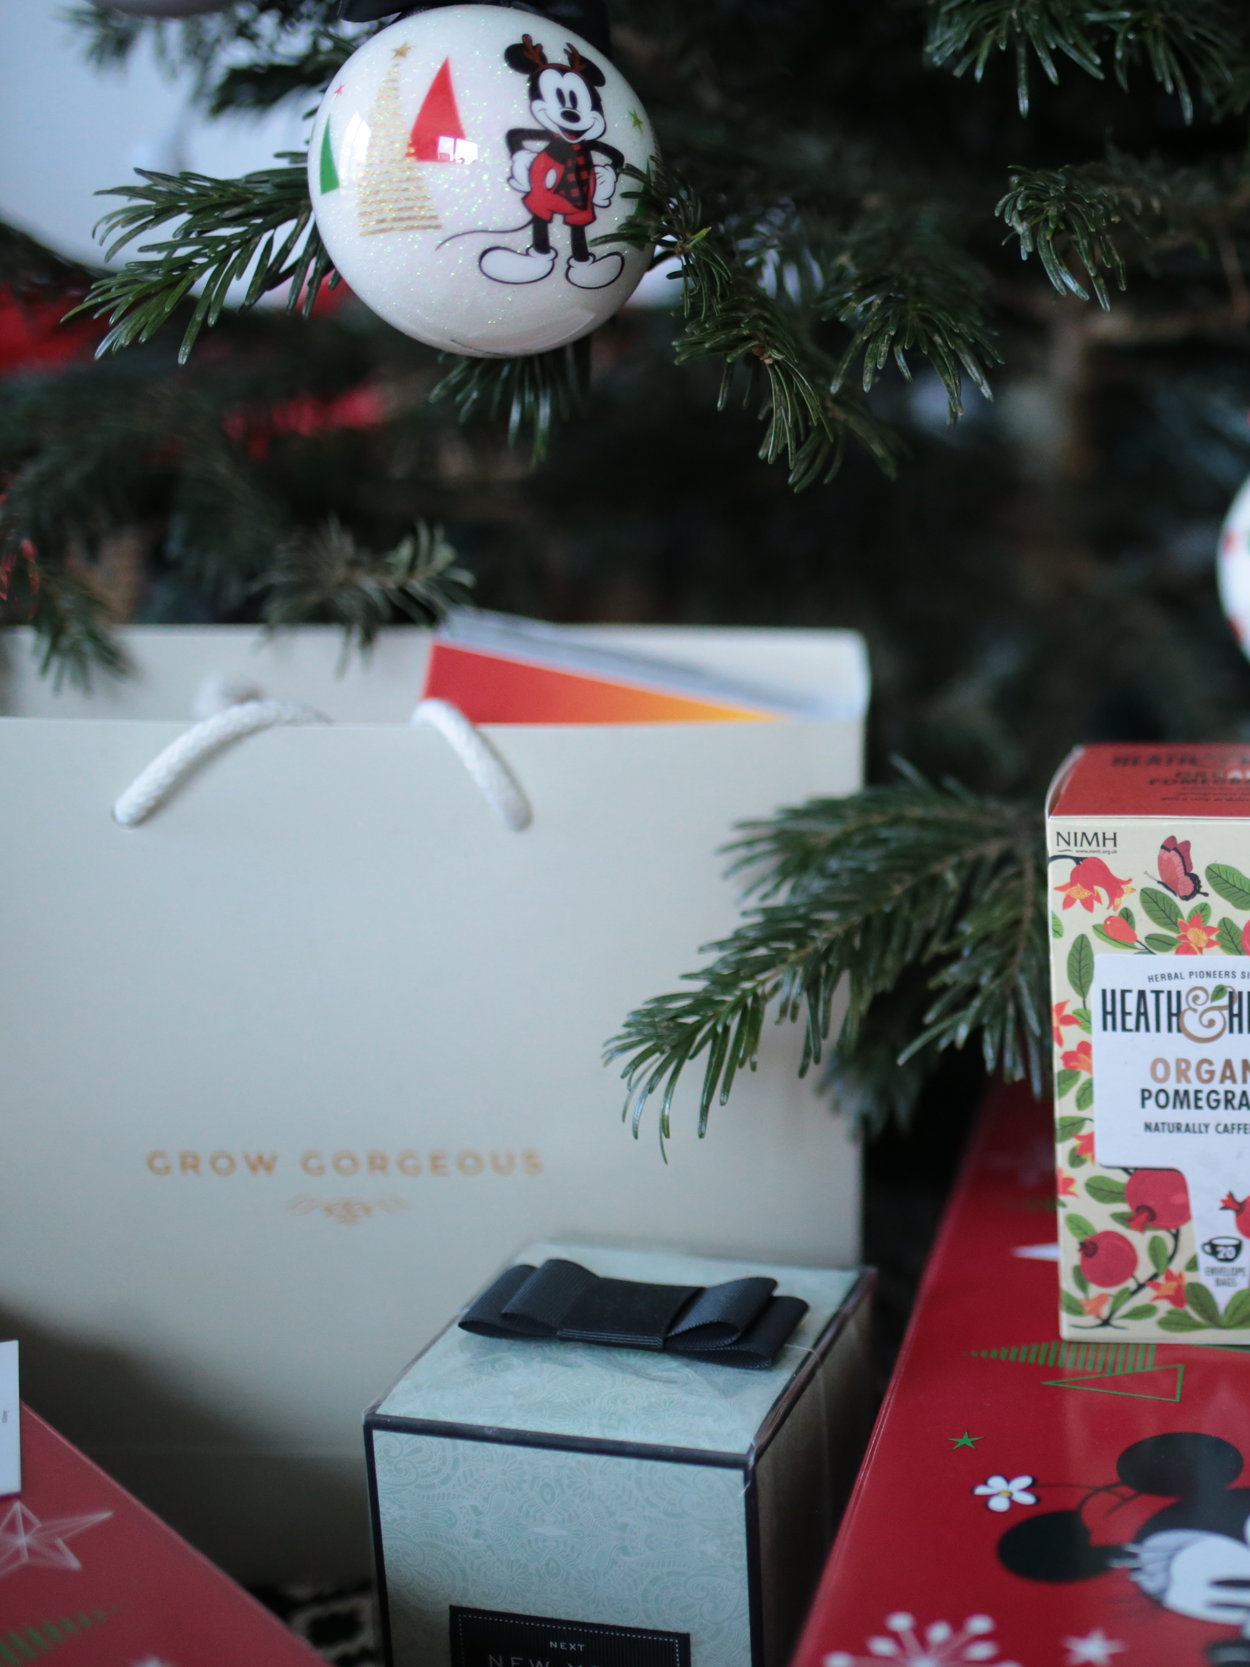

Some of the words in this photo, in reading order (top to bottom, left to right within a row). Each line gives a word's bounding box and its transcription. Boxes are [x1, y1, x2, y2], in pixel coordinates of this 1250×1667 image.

[1056, 831, 1118, 848] NIMH
[1148, 971, 1184, 983] HERBAL
[1188, 970, 1237, 981] PIONEERS
[1101, 988, 1182, 1034] HEATH
[1144, 1122, 1211, 1135] NATURALLY
[146, 1150, 279, 1177] GROW
[301, 1148, 545, 1177] GORGEOUS
[1216, 1246, 1236, 1260] 20
[549, 1640, 585, 1652] NEXT
